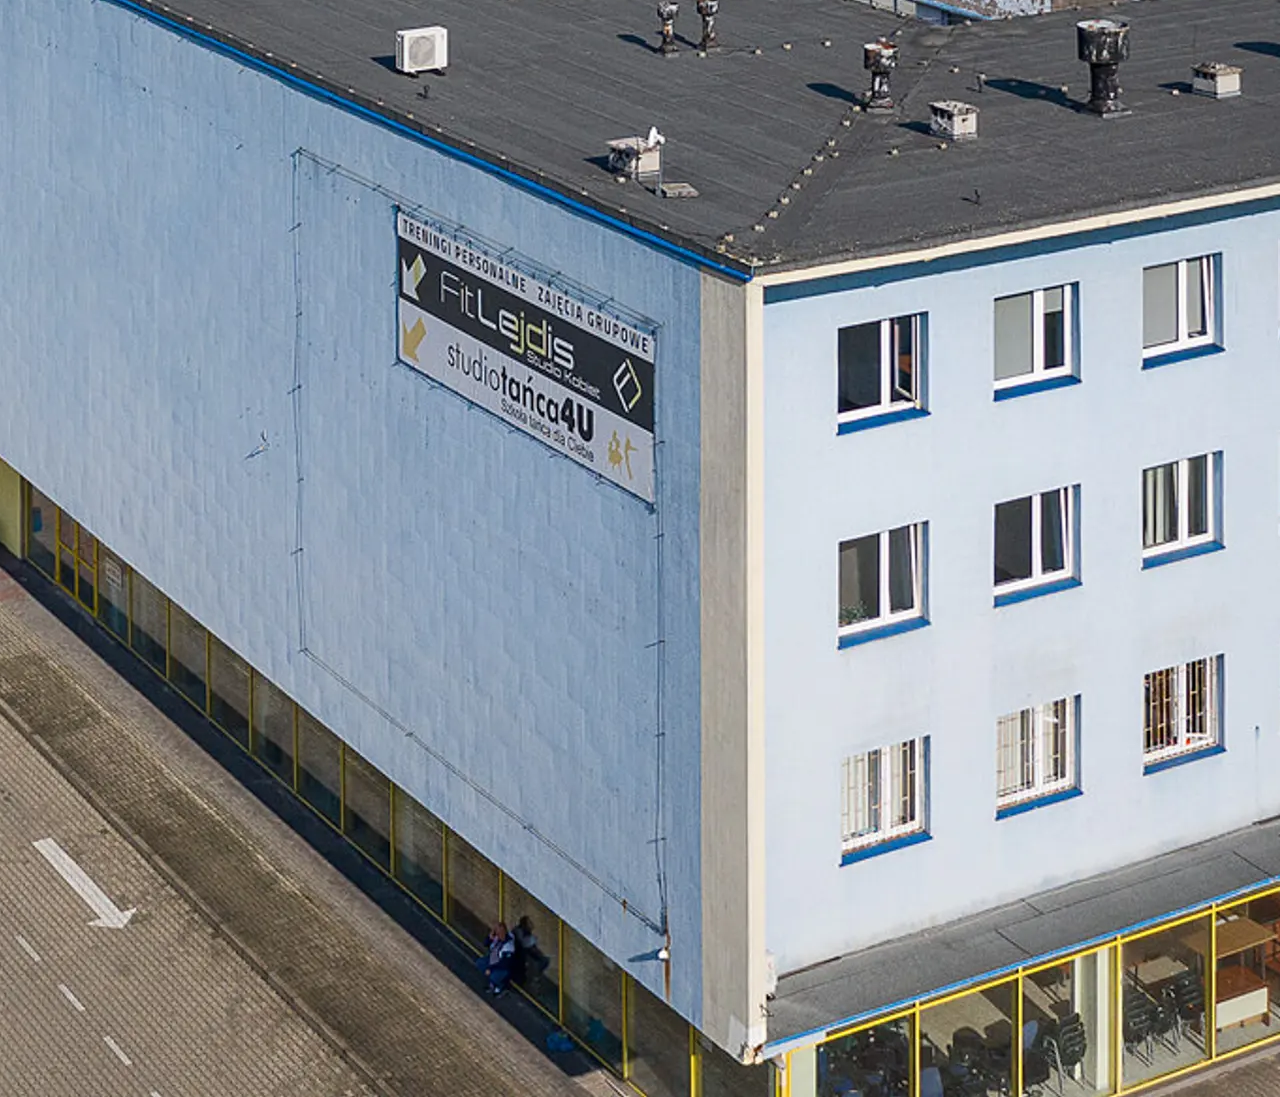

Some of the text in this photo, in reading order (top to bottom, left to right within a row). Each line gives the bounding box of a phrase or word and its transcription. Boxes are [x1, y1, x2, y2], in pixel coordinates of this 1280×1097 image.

[402, 218, 650, 354] TRENINGI PERSONALNE ZAJĘCIA GRUPOWE
